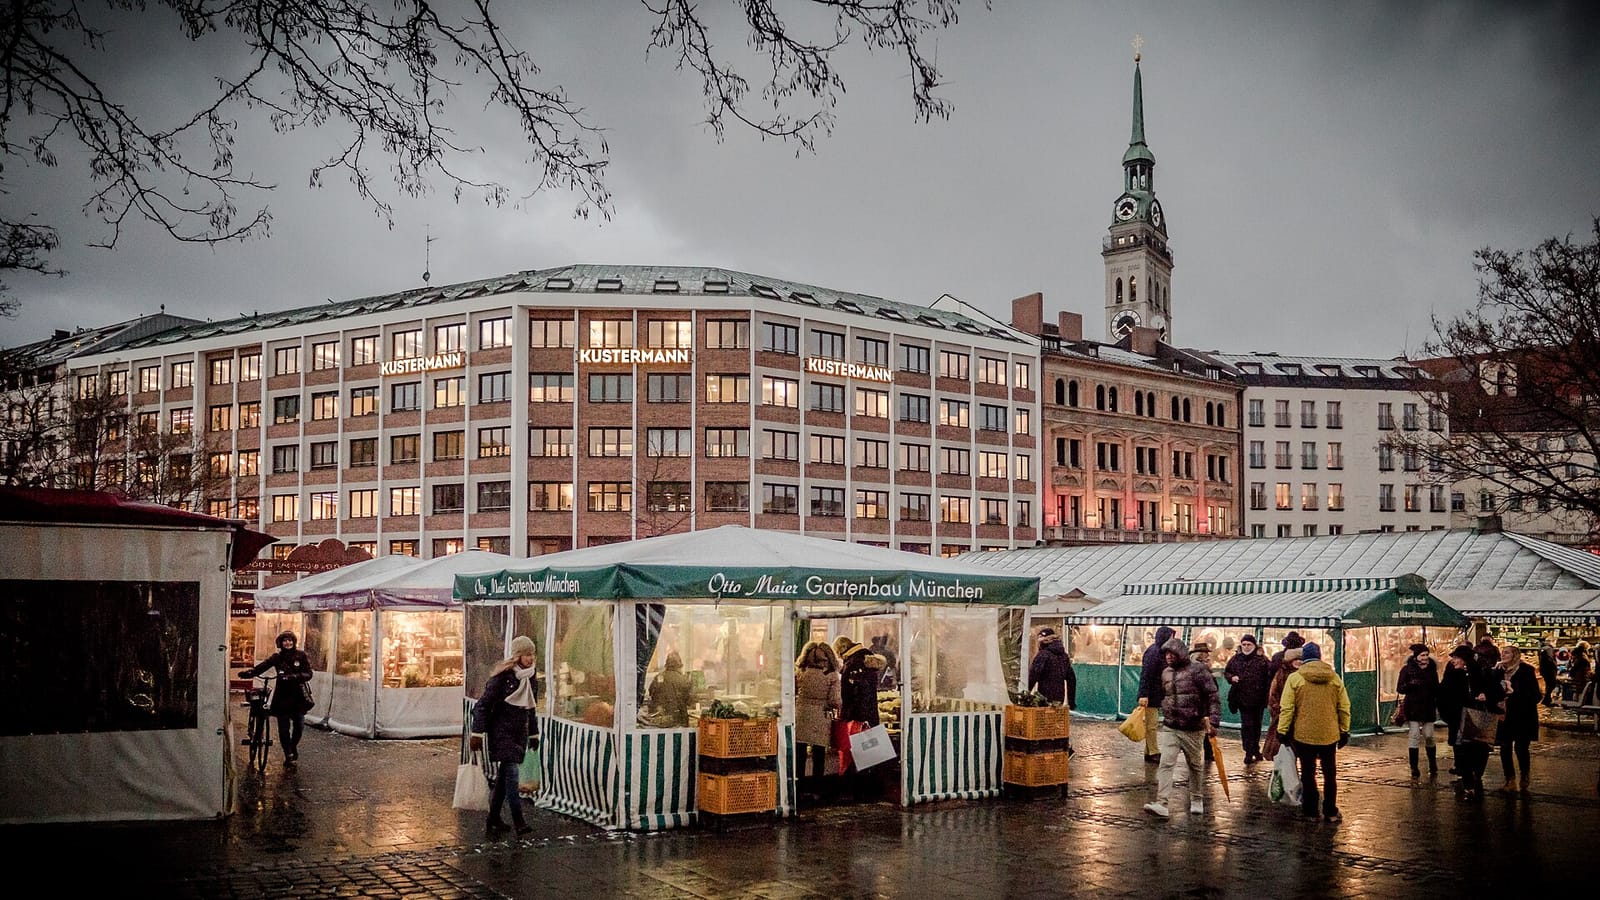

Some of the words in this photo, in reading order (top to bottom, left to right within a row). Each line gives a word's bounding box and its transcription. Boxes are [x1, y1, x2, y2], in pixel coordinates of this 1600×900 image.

[381, 353, 461, 376] KUSTERMANN
[580, 349, 689, 363] KUSTERMANN
[808, 358, 893, 382] KUSTERMANN
[507, 574, 545, 593] Gartenbau
[544, 571, 580, 593] München
[708, 572, 742, 593] Otto
[745, 574, 799, 596] Maier
[805, 575, 901, 596] Gartenbau
[908, 579, 983, 599] München
